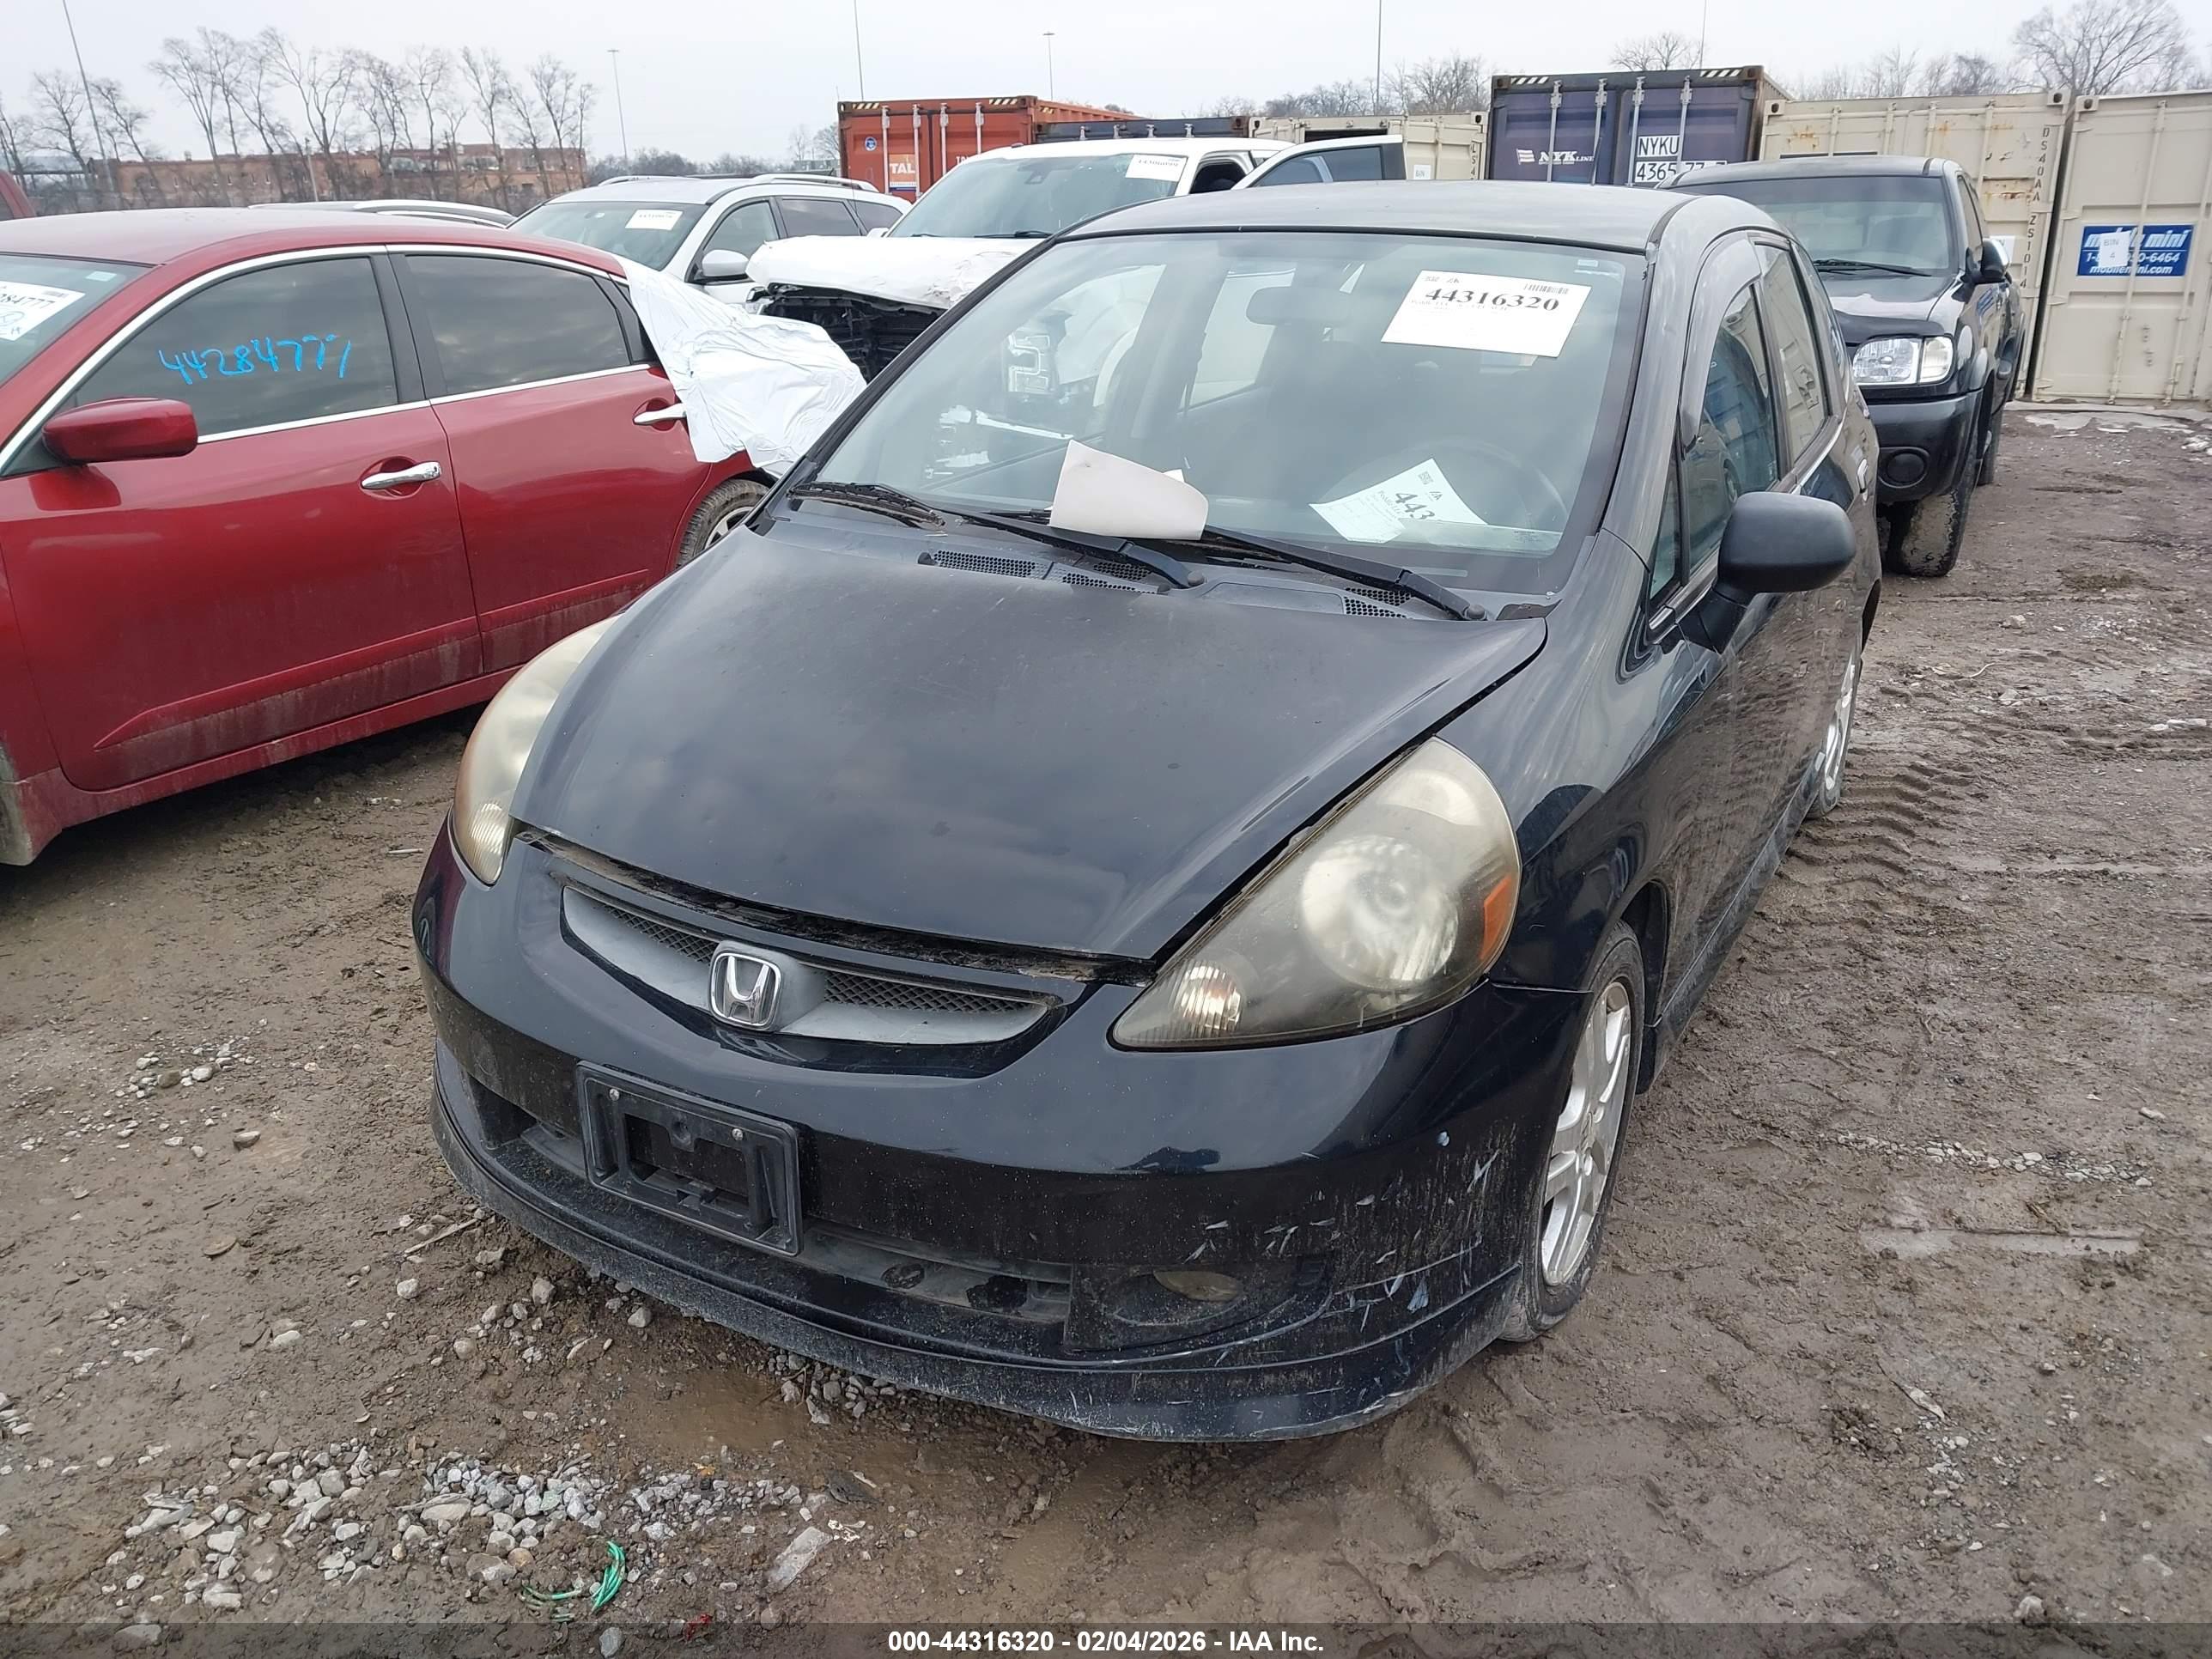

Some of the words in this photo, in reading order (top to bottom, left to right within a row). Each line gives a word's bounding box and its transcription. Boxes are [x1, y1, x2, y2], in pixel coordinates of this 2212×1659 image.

[1638, 137, 1680, 155] NYKU
[1538, 151, 1577, 161] NYK
[889, 162, 915, 174] TAL
[2143, 229, 2192, 248] mini
[1425, 289, 1559, 311] 44316320
